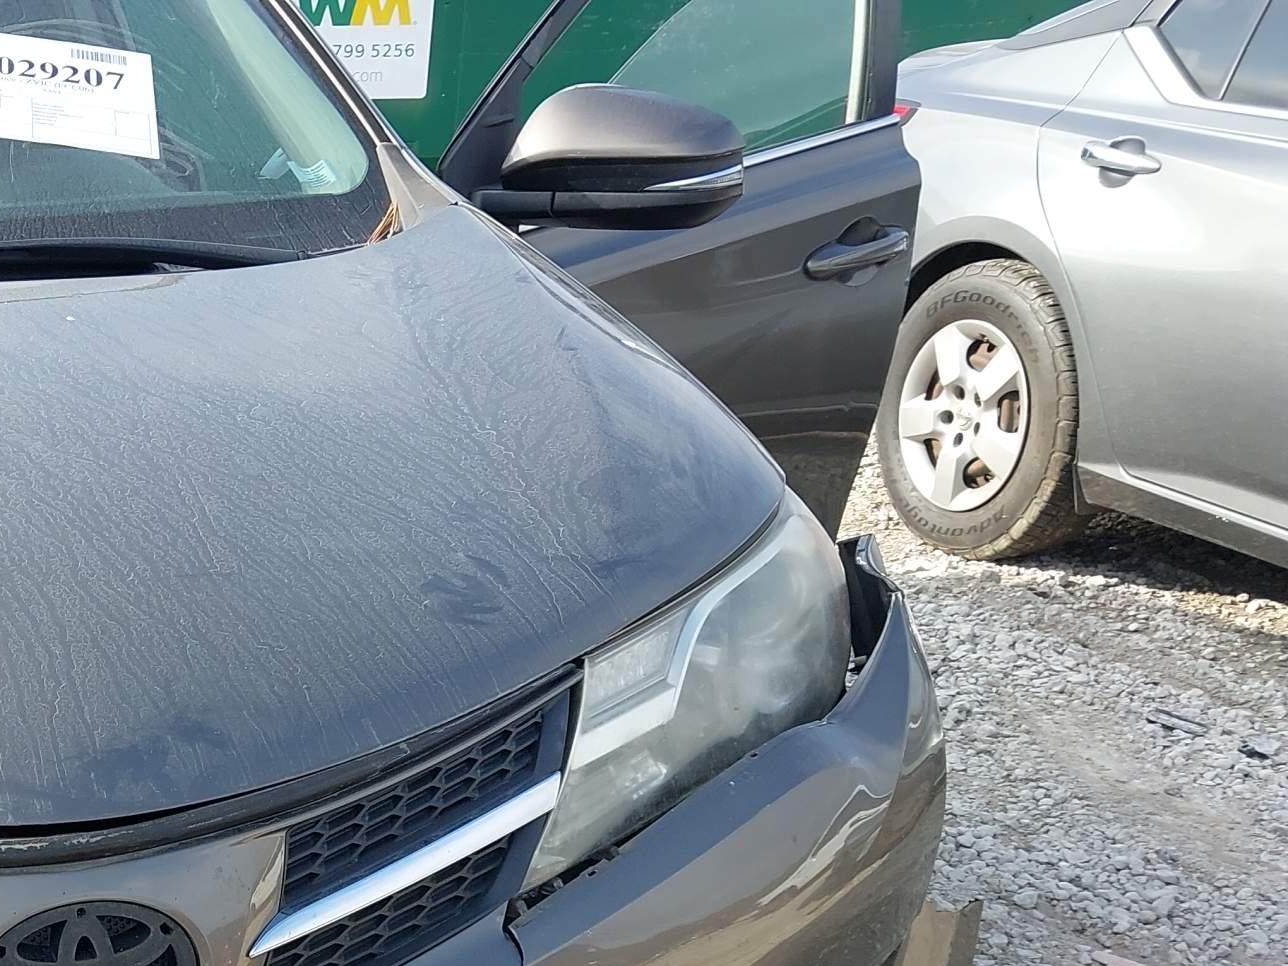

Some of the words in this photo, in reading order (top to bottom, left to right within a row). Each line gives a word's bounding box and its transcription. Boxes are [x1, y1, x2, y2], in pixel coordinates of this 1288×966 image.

[300, 0, 412, 26] WM
[333, 44, 365, 58] 799
[371, 44, 415, 58] 5256
